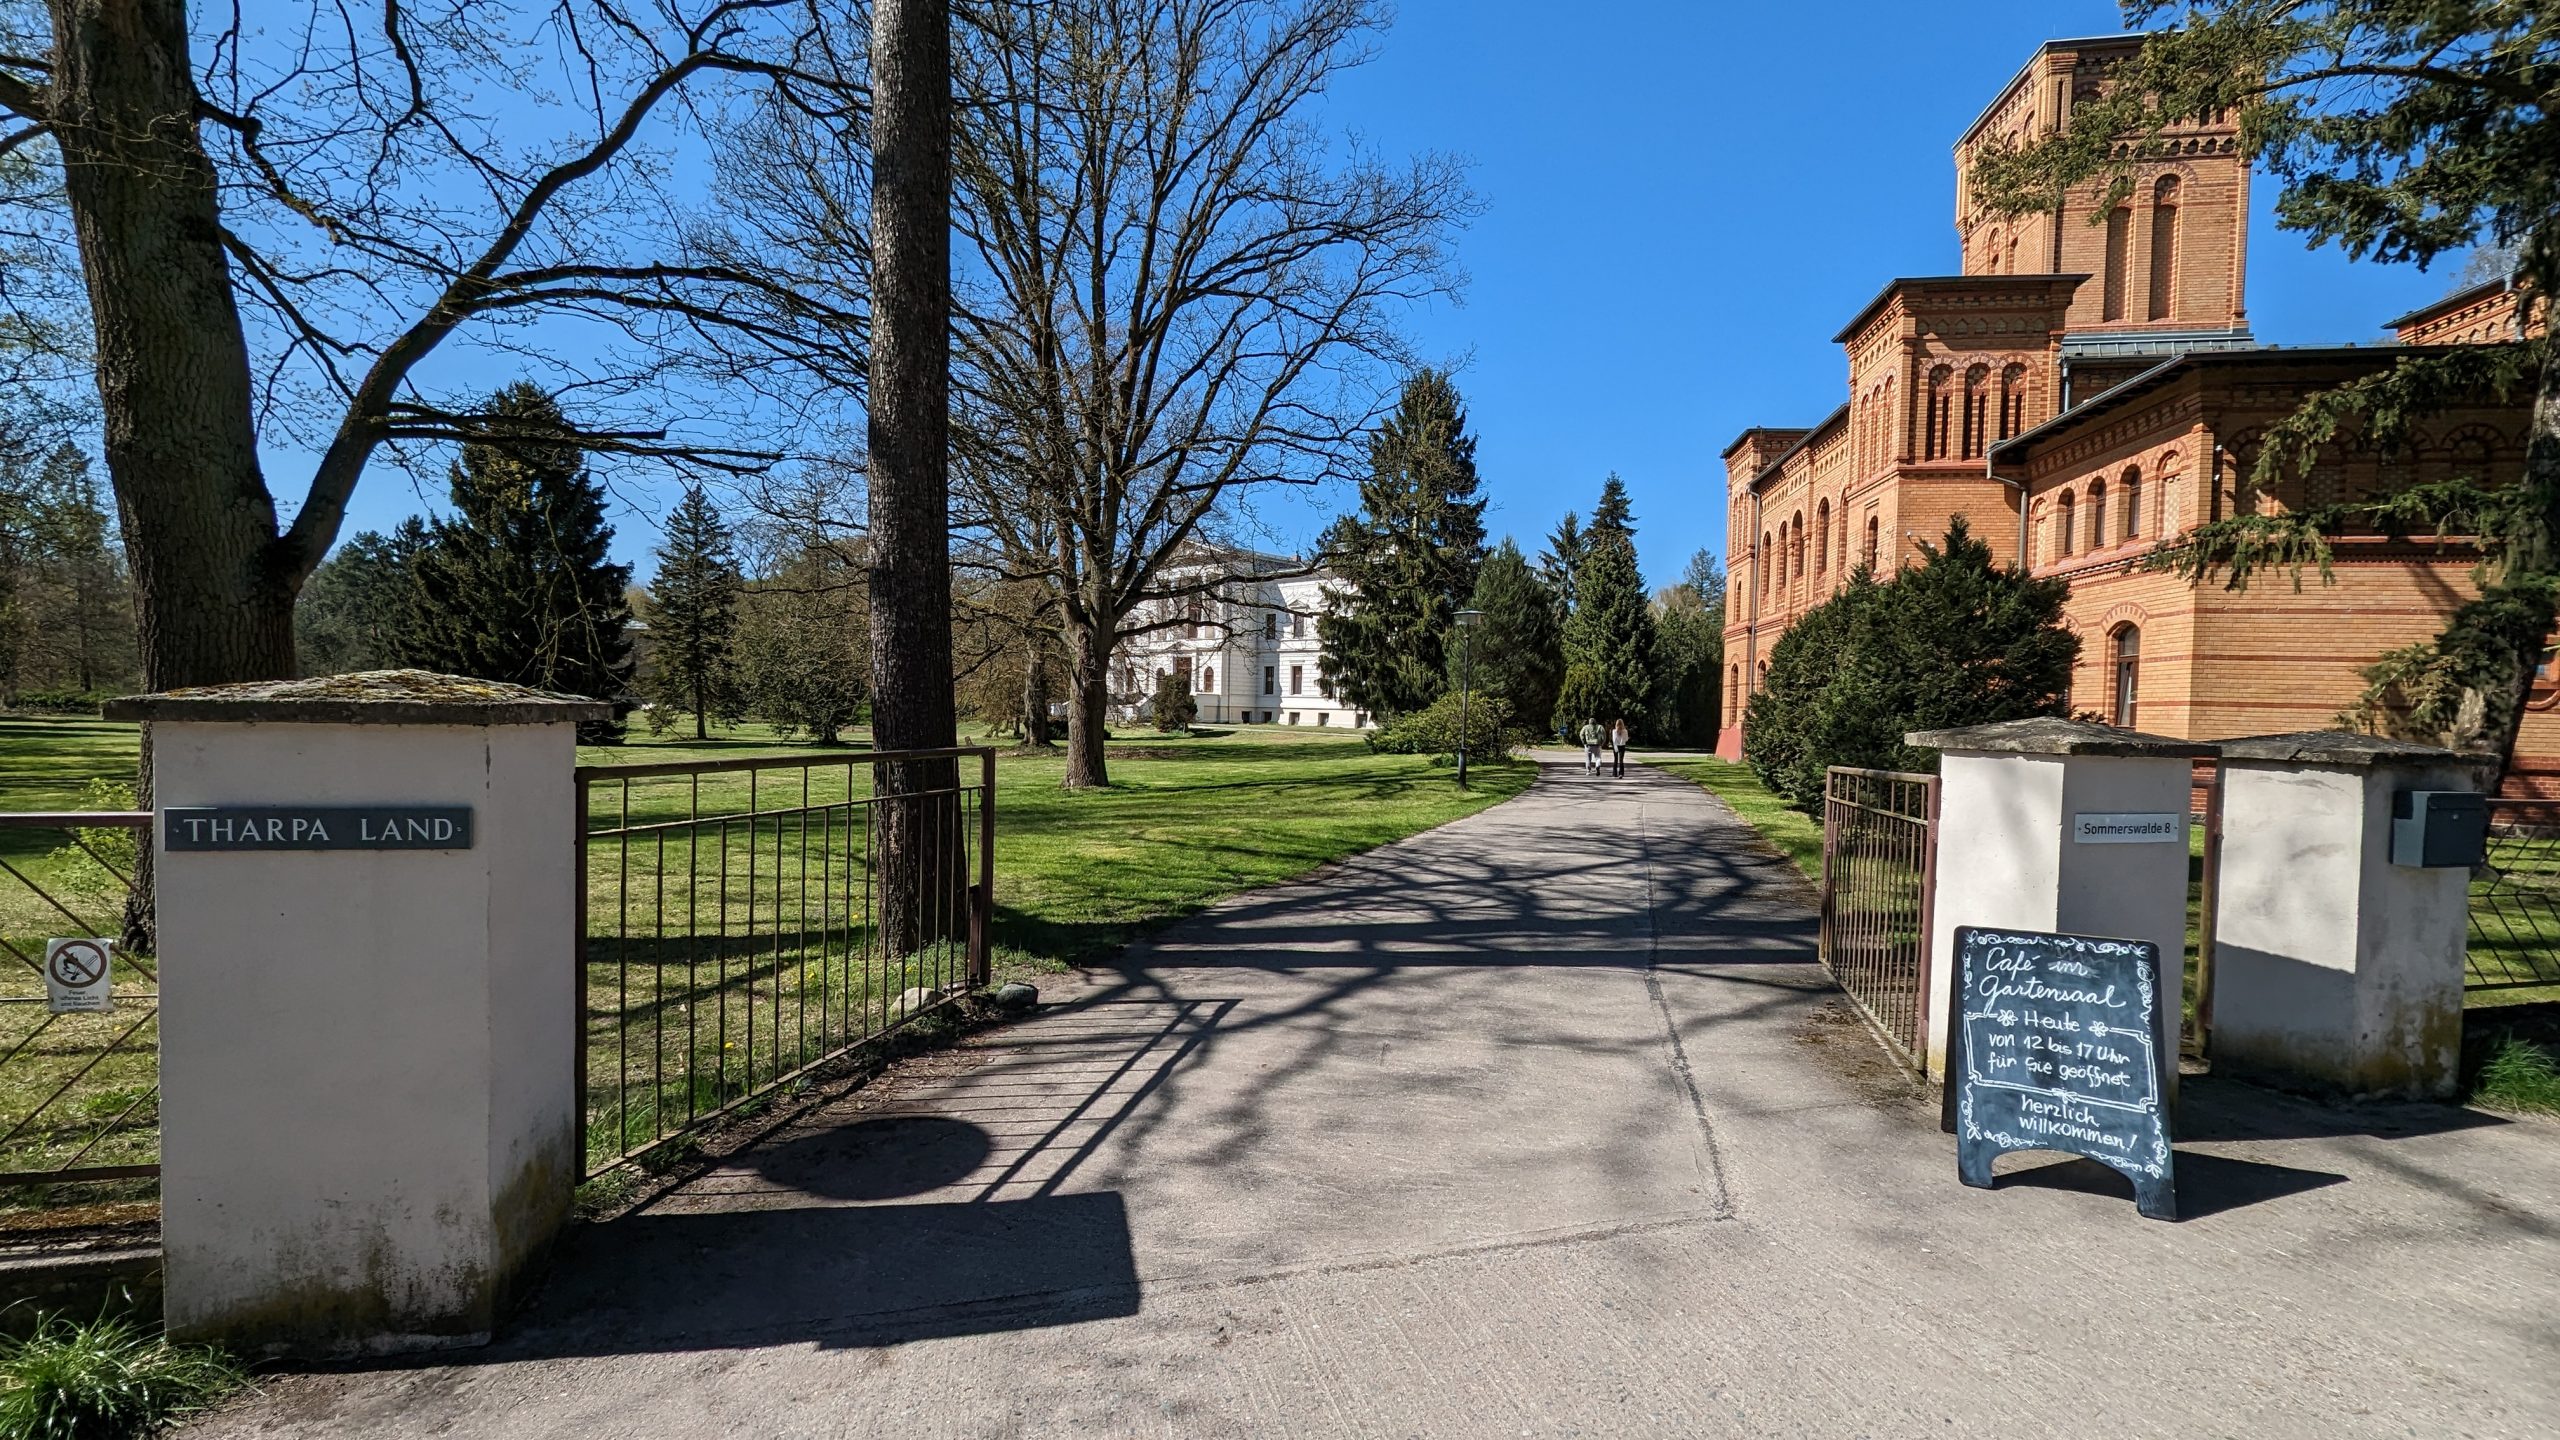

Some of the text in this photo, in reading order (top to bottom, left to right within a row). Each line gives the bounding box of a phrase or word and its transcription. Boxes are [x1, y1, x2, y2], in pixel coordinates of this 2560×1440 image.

[183, 817, 454, 842] THARPA LAND
[2083, 822, 2171, 835] Sommerswalde 8
[1985, 946, 2090, 981] Café im
[1979, 974, 2127, 1015] Gartensaal
[2024, 1010, 2081, 1032] Heute
[1988, 1033, 2131, 1064] von 12 bis 17 Uhr
[1987, 1051, 2131, 1088] für Sie geöffnet
[2021, 1094, 2100, 1128] herzlich
[2019, 1116, 2138, 1151] willkommen!
